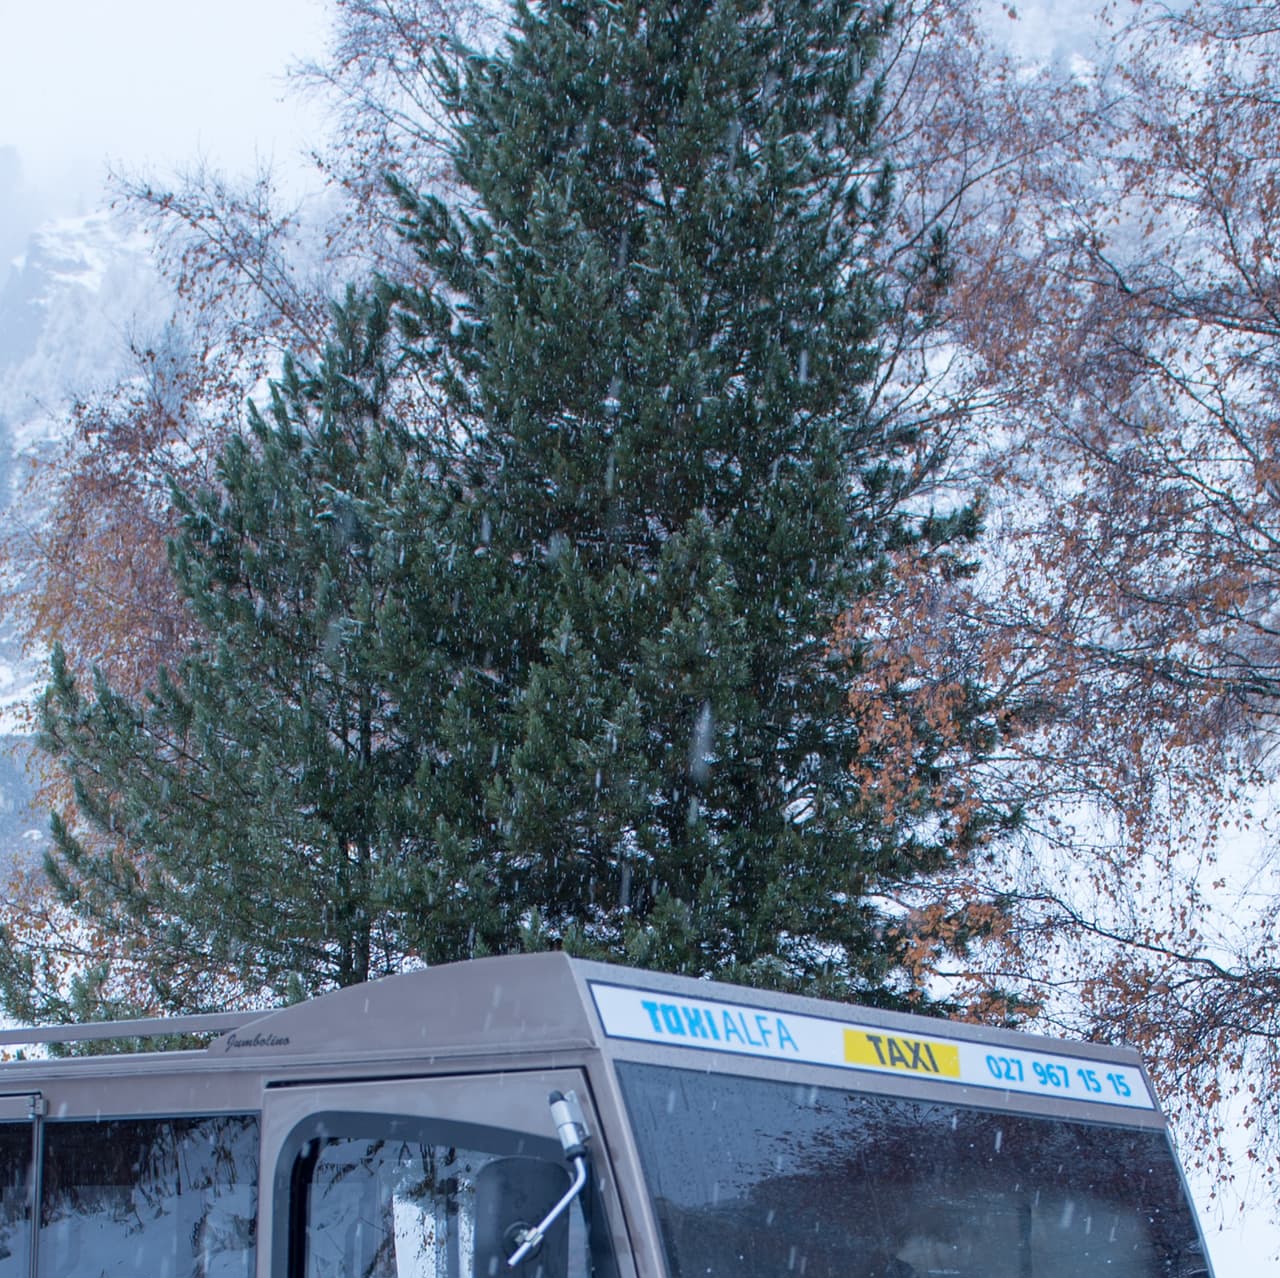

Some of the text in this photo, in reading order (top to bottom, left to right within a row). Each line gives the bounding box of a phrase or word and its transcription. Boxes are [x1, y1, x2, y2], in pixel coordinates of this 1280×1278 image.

[865, 1034, 941, 1074] TAXI
[985, 1054, 1025, 1082] 027
[1032, 1061, 1071, 1089] 967
[1077, 1068, 1102, 1094] 15
[1107, 1072, 1132, 1097] 15
